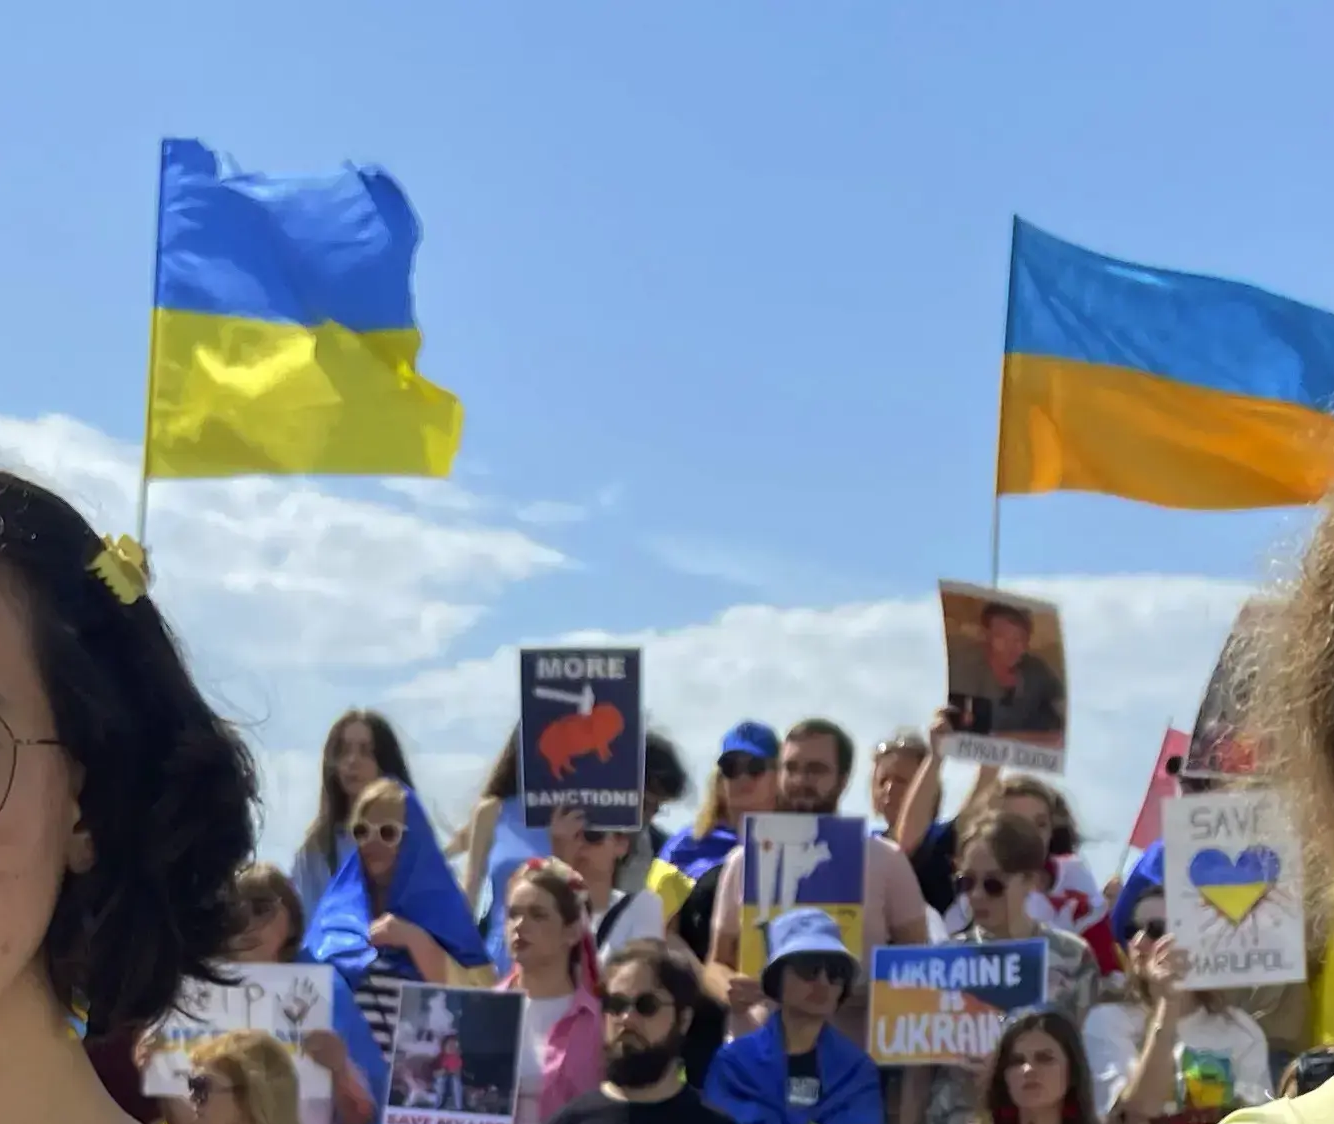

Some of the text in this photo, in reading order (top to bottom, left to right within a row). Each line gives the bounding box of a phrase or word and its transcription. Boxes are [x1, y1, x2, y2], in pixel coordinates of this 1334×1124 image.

[535, 657, 626, 679] MORE
[526, 789, 639, 807] SANCTIONS
[888, 954, 1021, 990] UKRAINE
